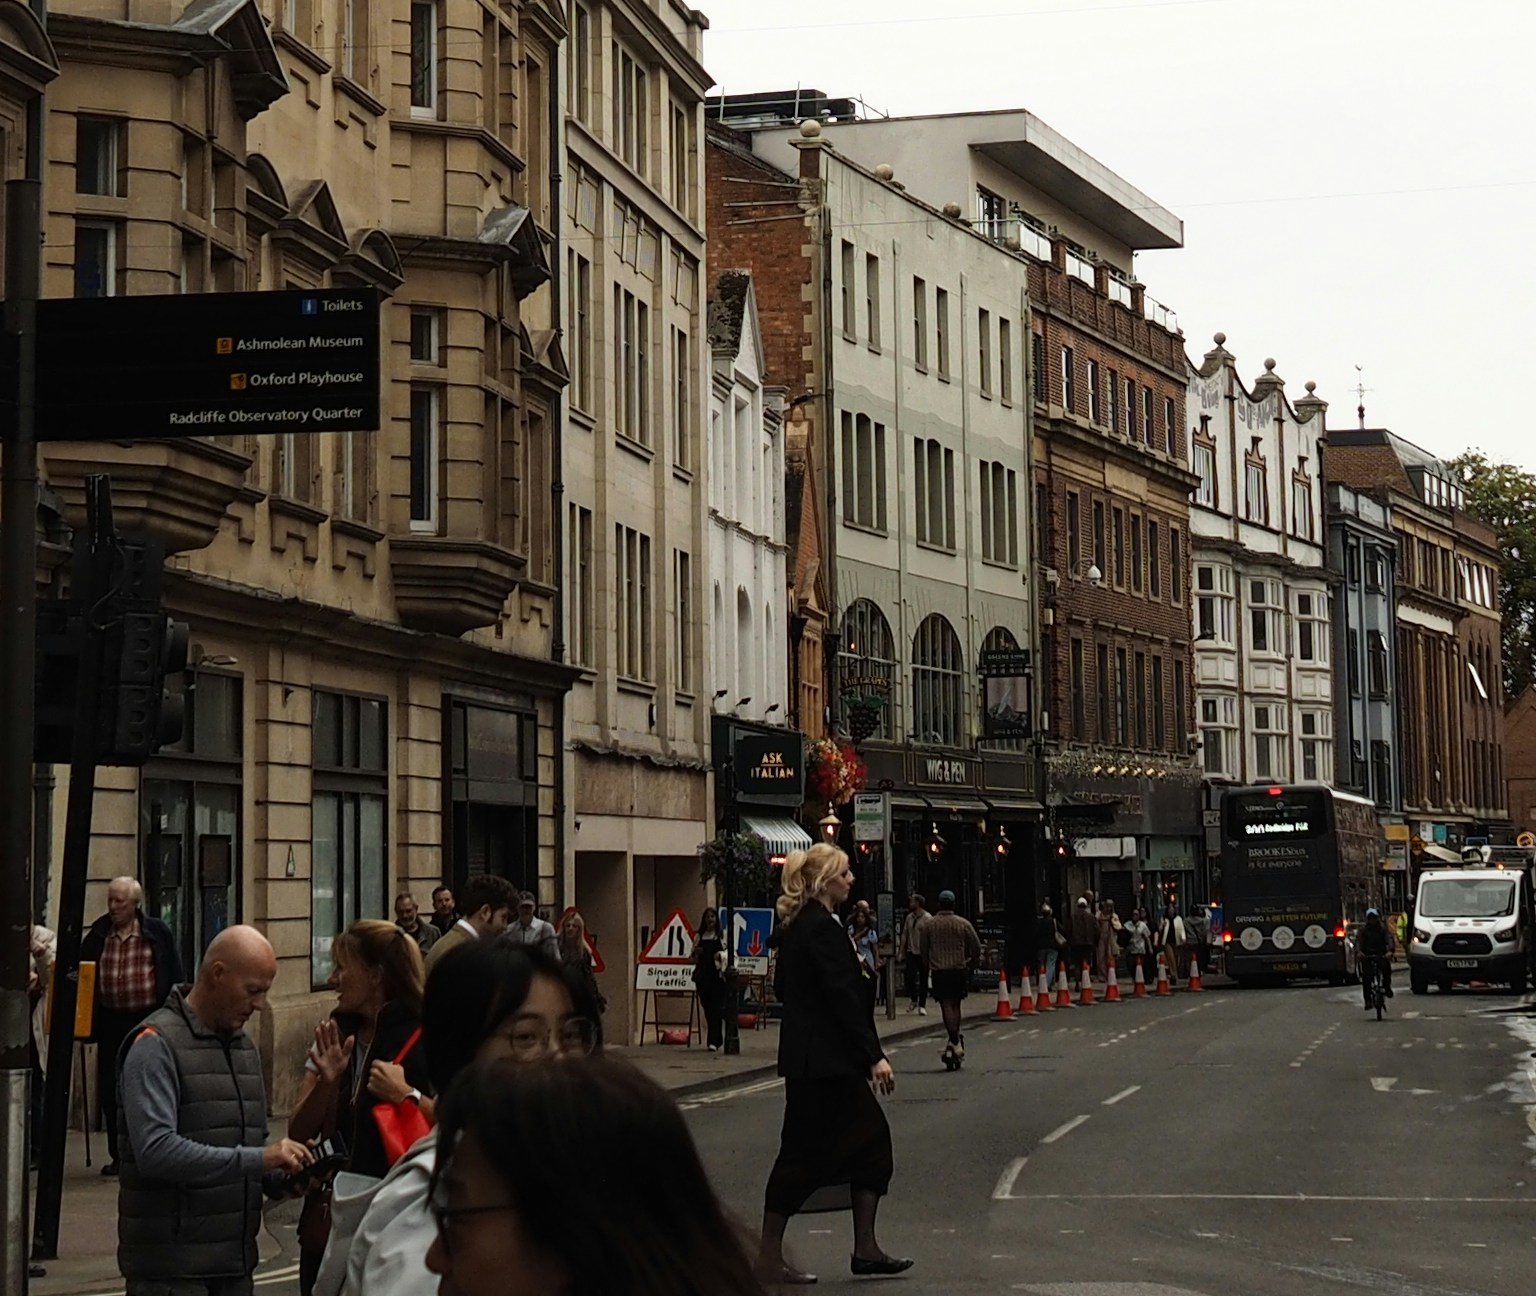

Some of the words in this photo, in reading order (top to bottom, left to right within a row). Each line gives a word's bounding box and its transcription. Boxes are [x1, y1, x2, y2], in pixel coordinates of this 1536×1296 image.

[321, 299, 364, 312] Toilets
[236, 337, 306, 351] Ashmolean
[309, 335, 364, 349] Museum
[250, 373, 295, 387] Oxford
[298, 370, 364, 387] Playhouse
[169, 410, 226, 424] Radcliffe
[228, 407, 310, 423] Observatory
[312, 406, 364, 420] Quarter
[762, 752, 784, 764] ASK
[750, 766, 795, 780] ITALIAN
[927, 759, 943, 781] WIG
[944, 761, 950, 782] &
[951, 762, 965, 783] PEN
[647, 967, 678, 977] Single
[681, 965, 692, 976] fil
[655, 977, 687, 987] traffic
